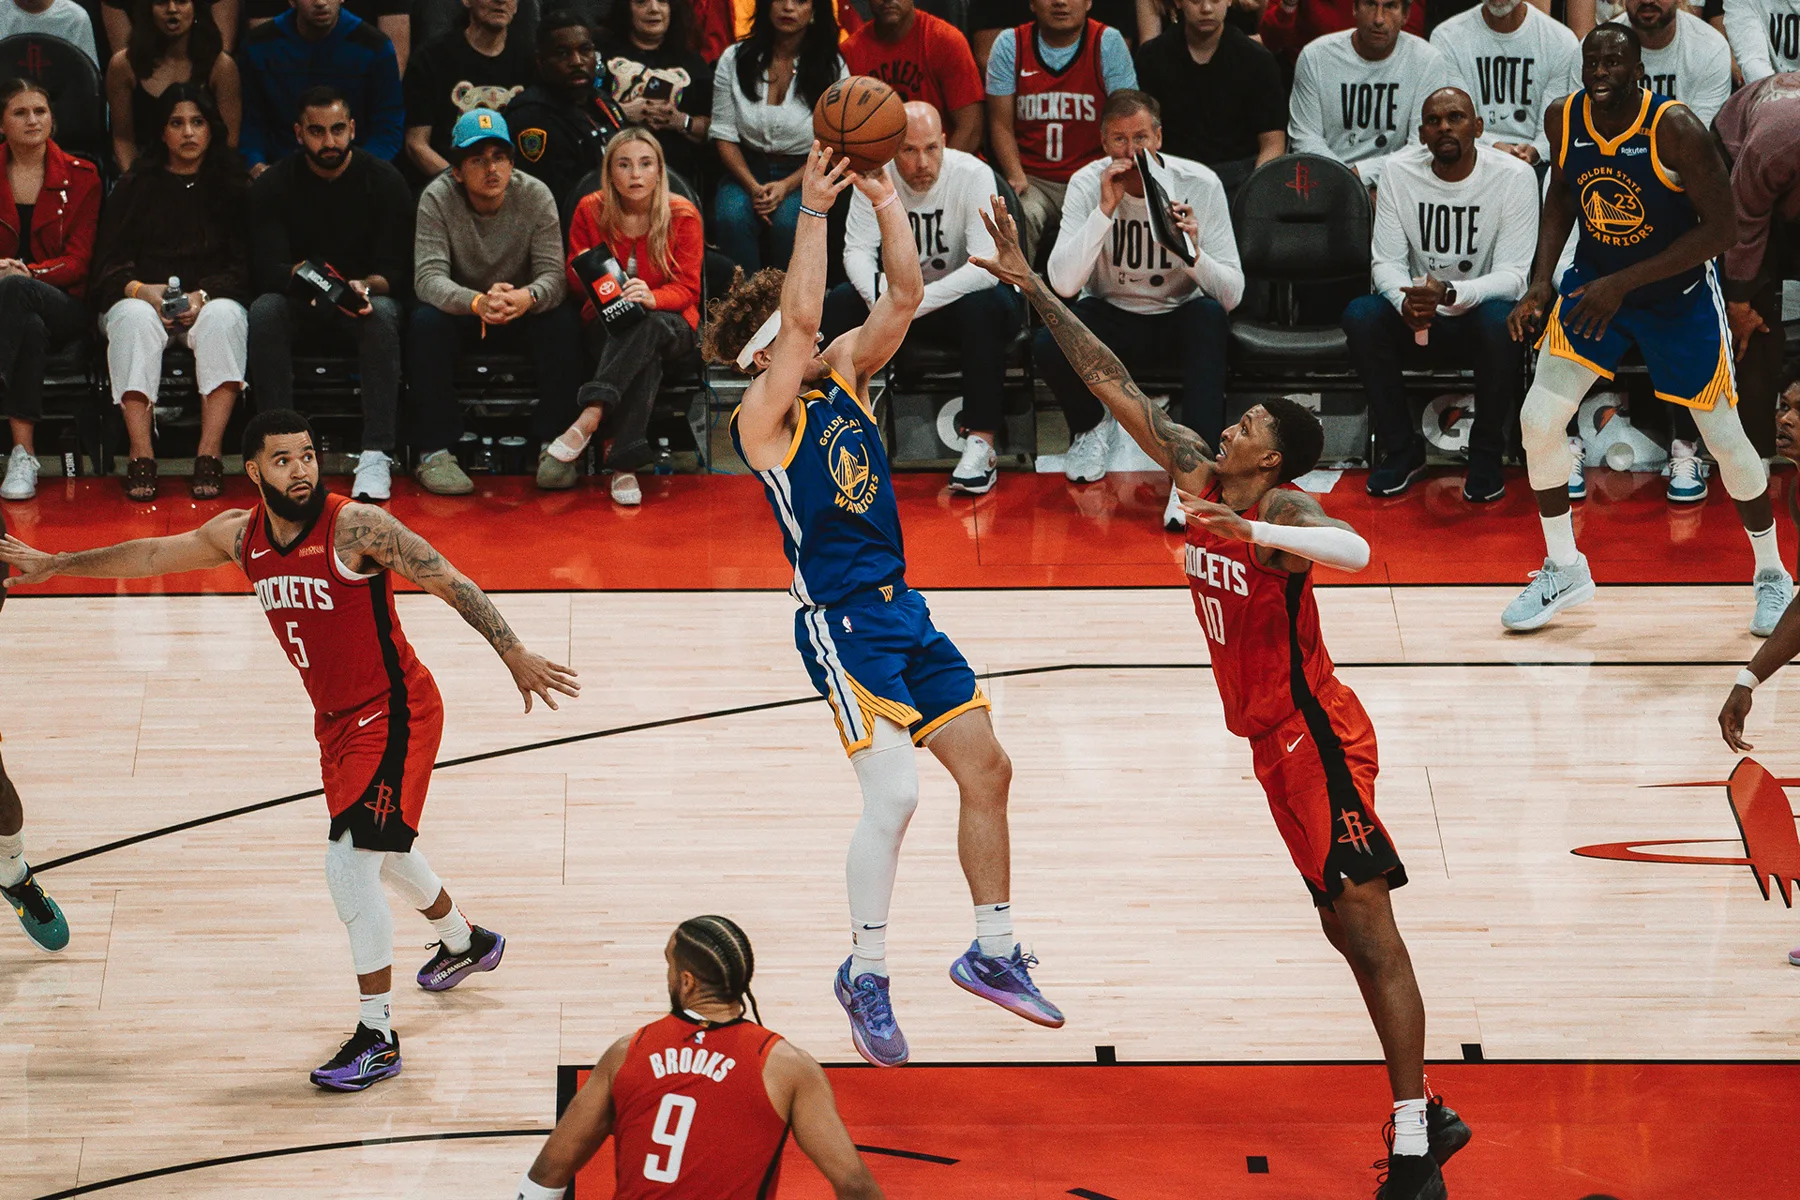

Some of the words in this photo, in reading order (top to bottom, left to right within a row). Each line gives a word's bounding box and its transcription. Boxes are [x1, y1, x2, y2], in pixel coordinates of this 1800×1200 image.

[1770, 13, 1800, 60] VO
[1476, 56, 1534, 106] VOTE
[1016, 91, 1096, 122] ROCKETS
[1341, 83, 1399, 131] VOTE
[1046, 122, 1063, 162] 0
[1621, 147, 1648, 156] Rakuten
[1577, 166, 1613, 186] GOLDEN
[1616, 170, 1642, 194] STATE
[1614, 193, 1637, 210] 23
[908, 209, 949, 256] OTE
[1419, 202, 1480, 255] VOTE
[1585, 220, 1654, 247] WARRIORS
[602, 298, 633, 316] TOYOT
[605, 303, 635, 323] CENTER
[819, 415, 848, 446] GOLDE
[1198, 591, 1226, 646] 10
[285, 621, 310, 669] 5
[649, 1047, 736, 1082] BROOKS
[643, 1092, 697, 1184] 9
